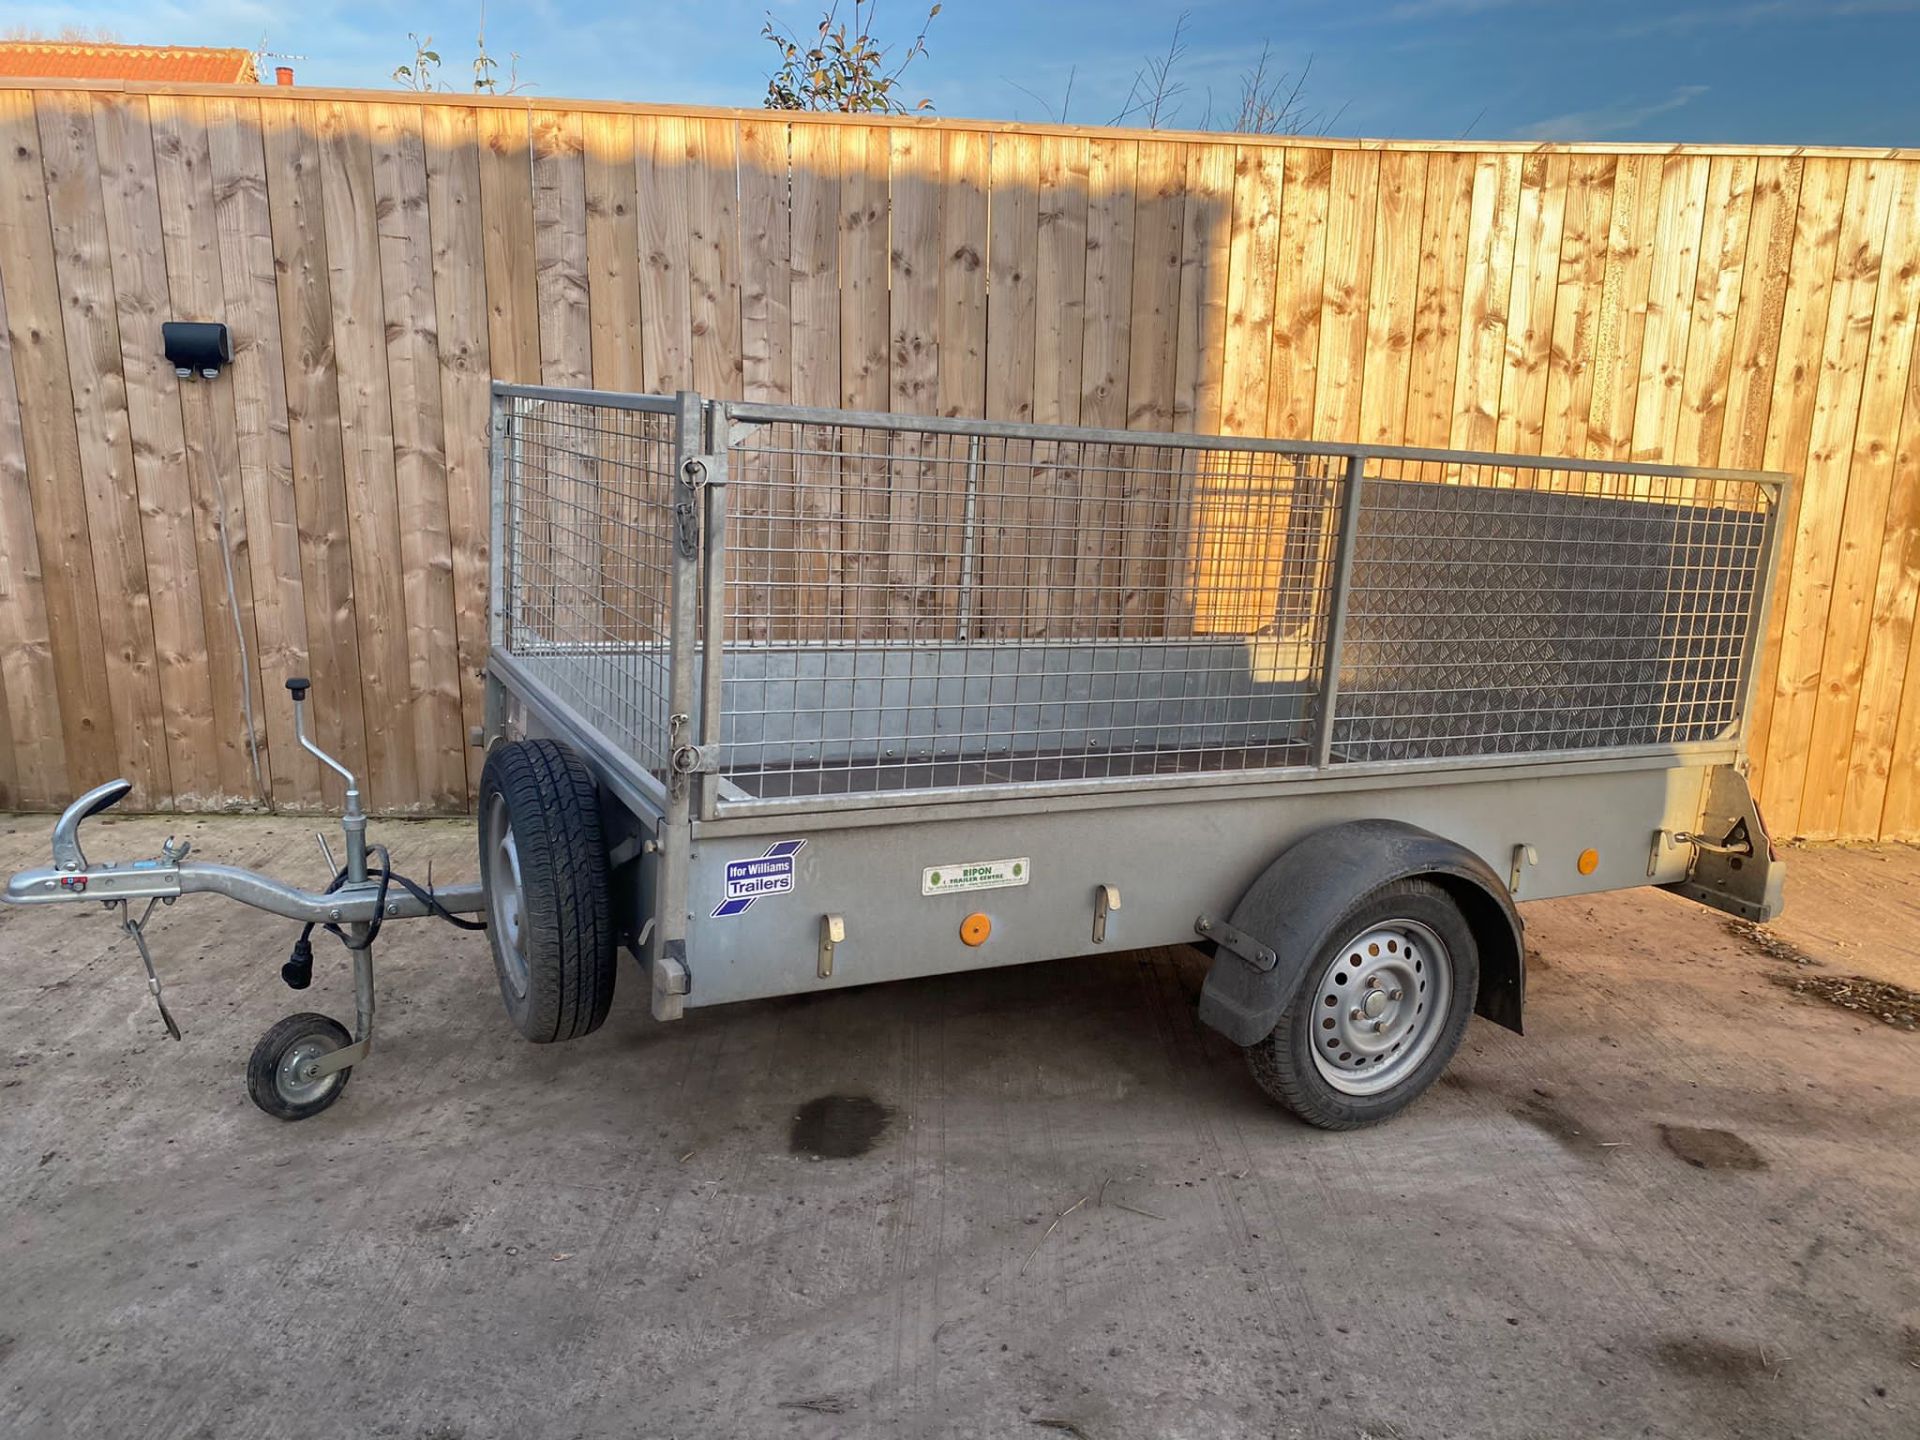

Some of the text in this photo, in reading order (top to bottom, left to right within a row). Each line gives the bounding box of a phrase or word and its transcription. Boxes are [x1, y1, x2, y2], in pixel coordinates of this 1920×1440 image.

[729, 862, 790, 878] Ifor Williams
[963, 866, 992, 877] RIPON
[730, 877, 789, 894] Trailers
